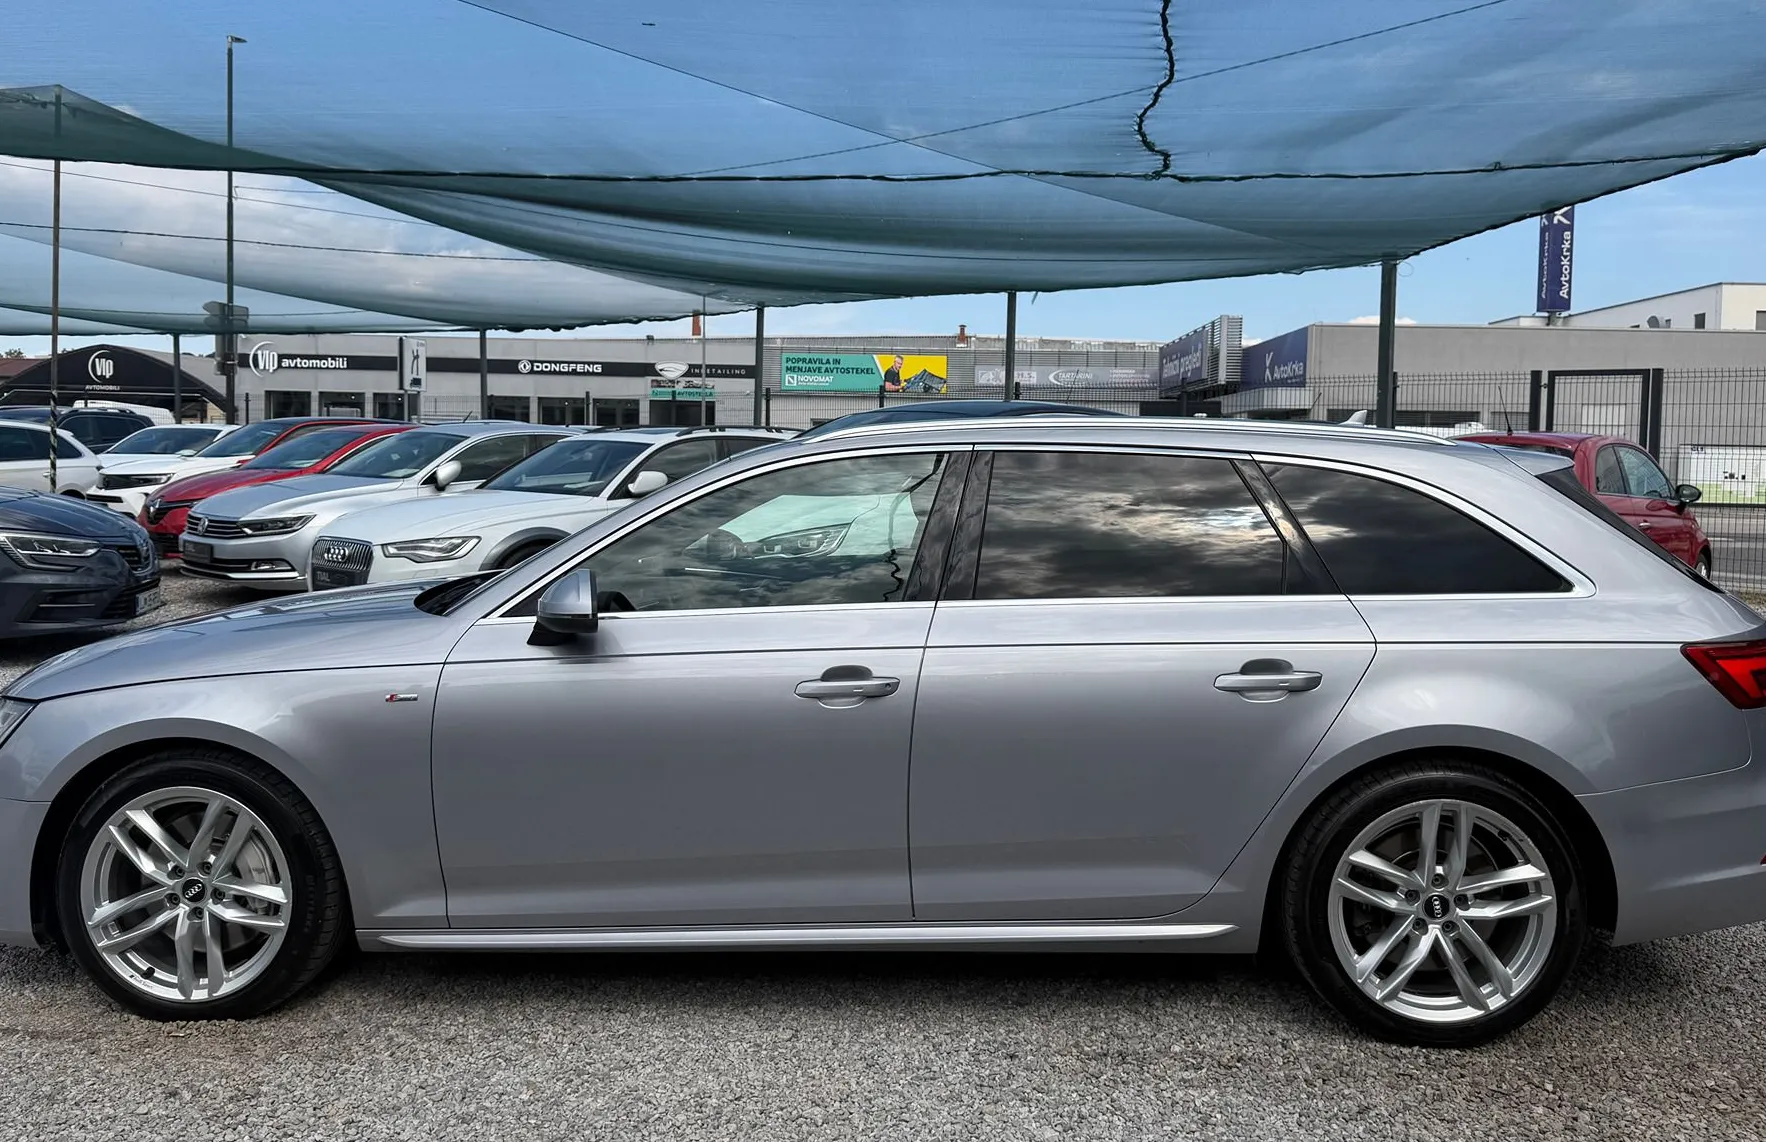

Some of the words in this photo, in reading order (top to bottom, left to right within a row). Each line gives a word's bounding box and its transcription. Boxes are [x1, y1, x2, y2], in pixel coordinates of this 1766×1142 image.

[1559, 231, 1571, 299] AvtoKrka
[281, 357, 347, 368] avtomobili
[785, 357, 831, 365] POPRAVILA
[533, 362, 602, 373] DONGFENG
[785, 366, 823, 374] MENJAVE
[824, 367, 876, 375] AVTOSTEKEL
[1273, 360, 1304, 380] AvtoKrka
[797, 375, 834, 383] NOVOMAT
